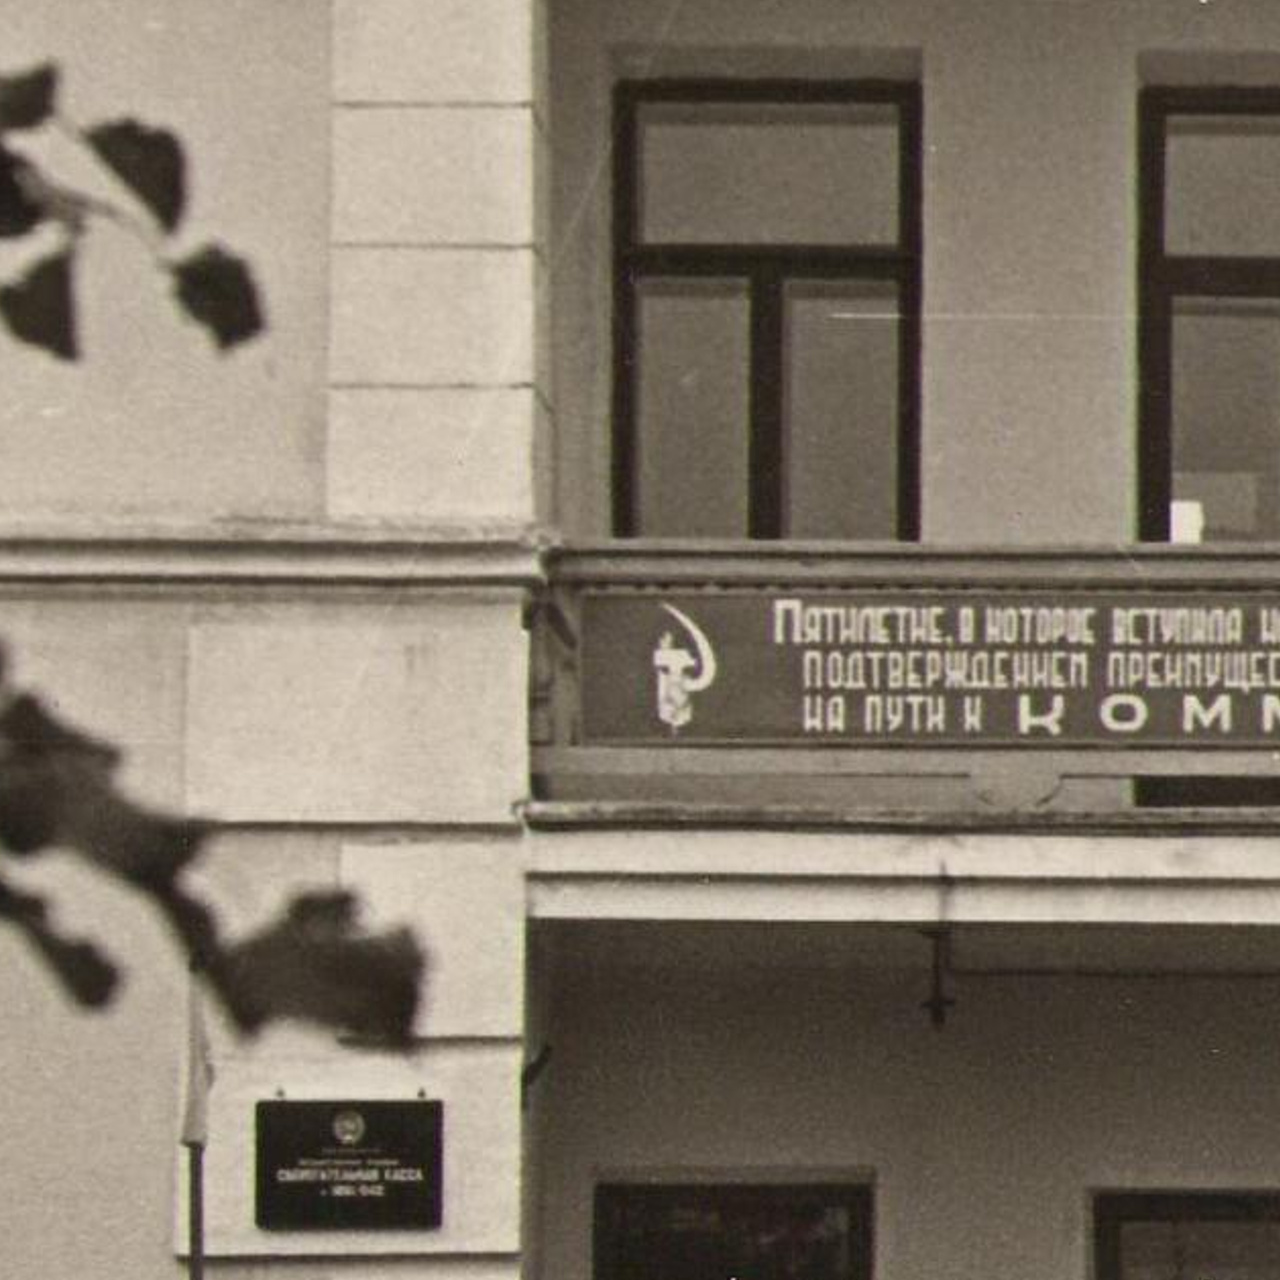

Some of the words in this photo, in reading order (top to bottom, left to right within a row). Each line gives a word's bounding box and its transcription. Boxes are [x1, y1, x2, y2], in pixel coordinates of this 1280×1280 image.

[959, 607, 974, 645] В
[985, 607, 1095, 645] КОТОРОЕ
[1112, 607, 1242, 645] ВСТУПИЛА
[804, 651, 1088, 690] ПОДТВЕРЖДЕНИЕМ
[803, 694, 846, 733] НА
[864, 694, 946, 733] ПУТИ
[963, 694, 983, 733] К
